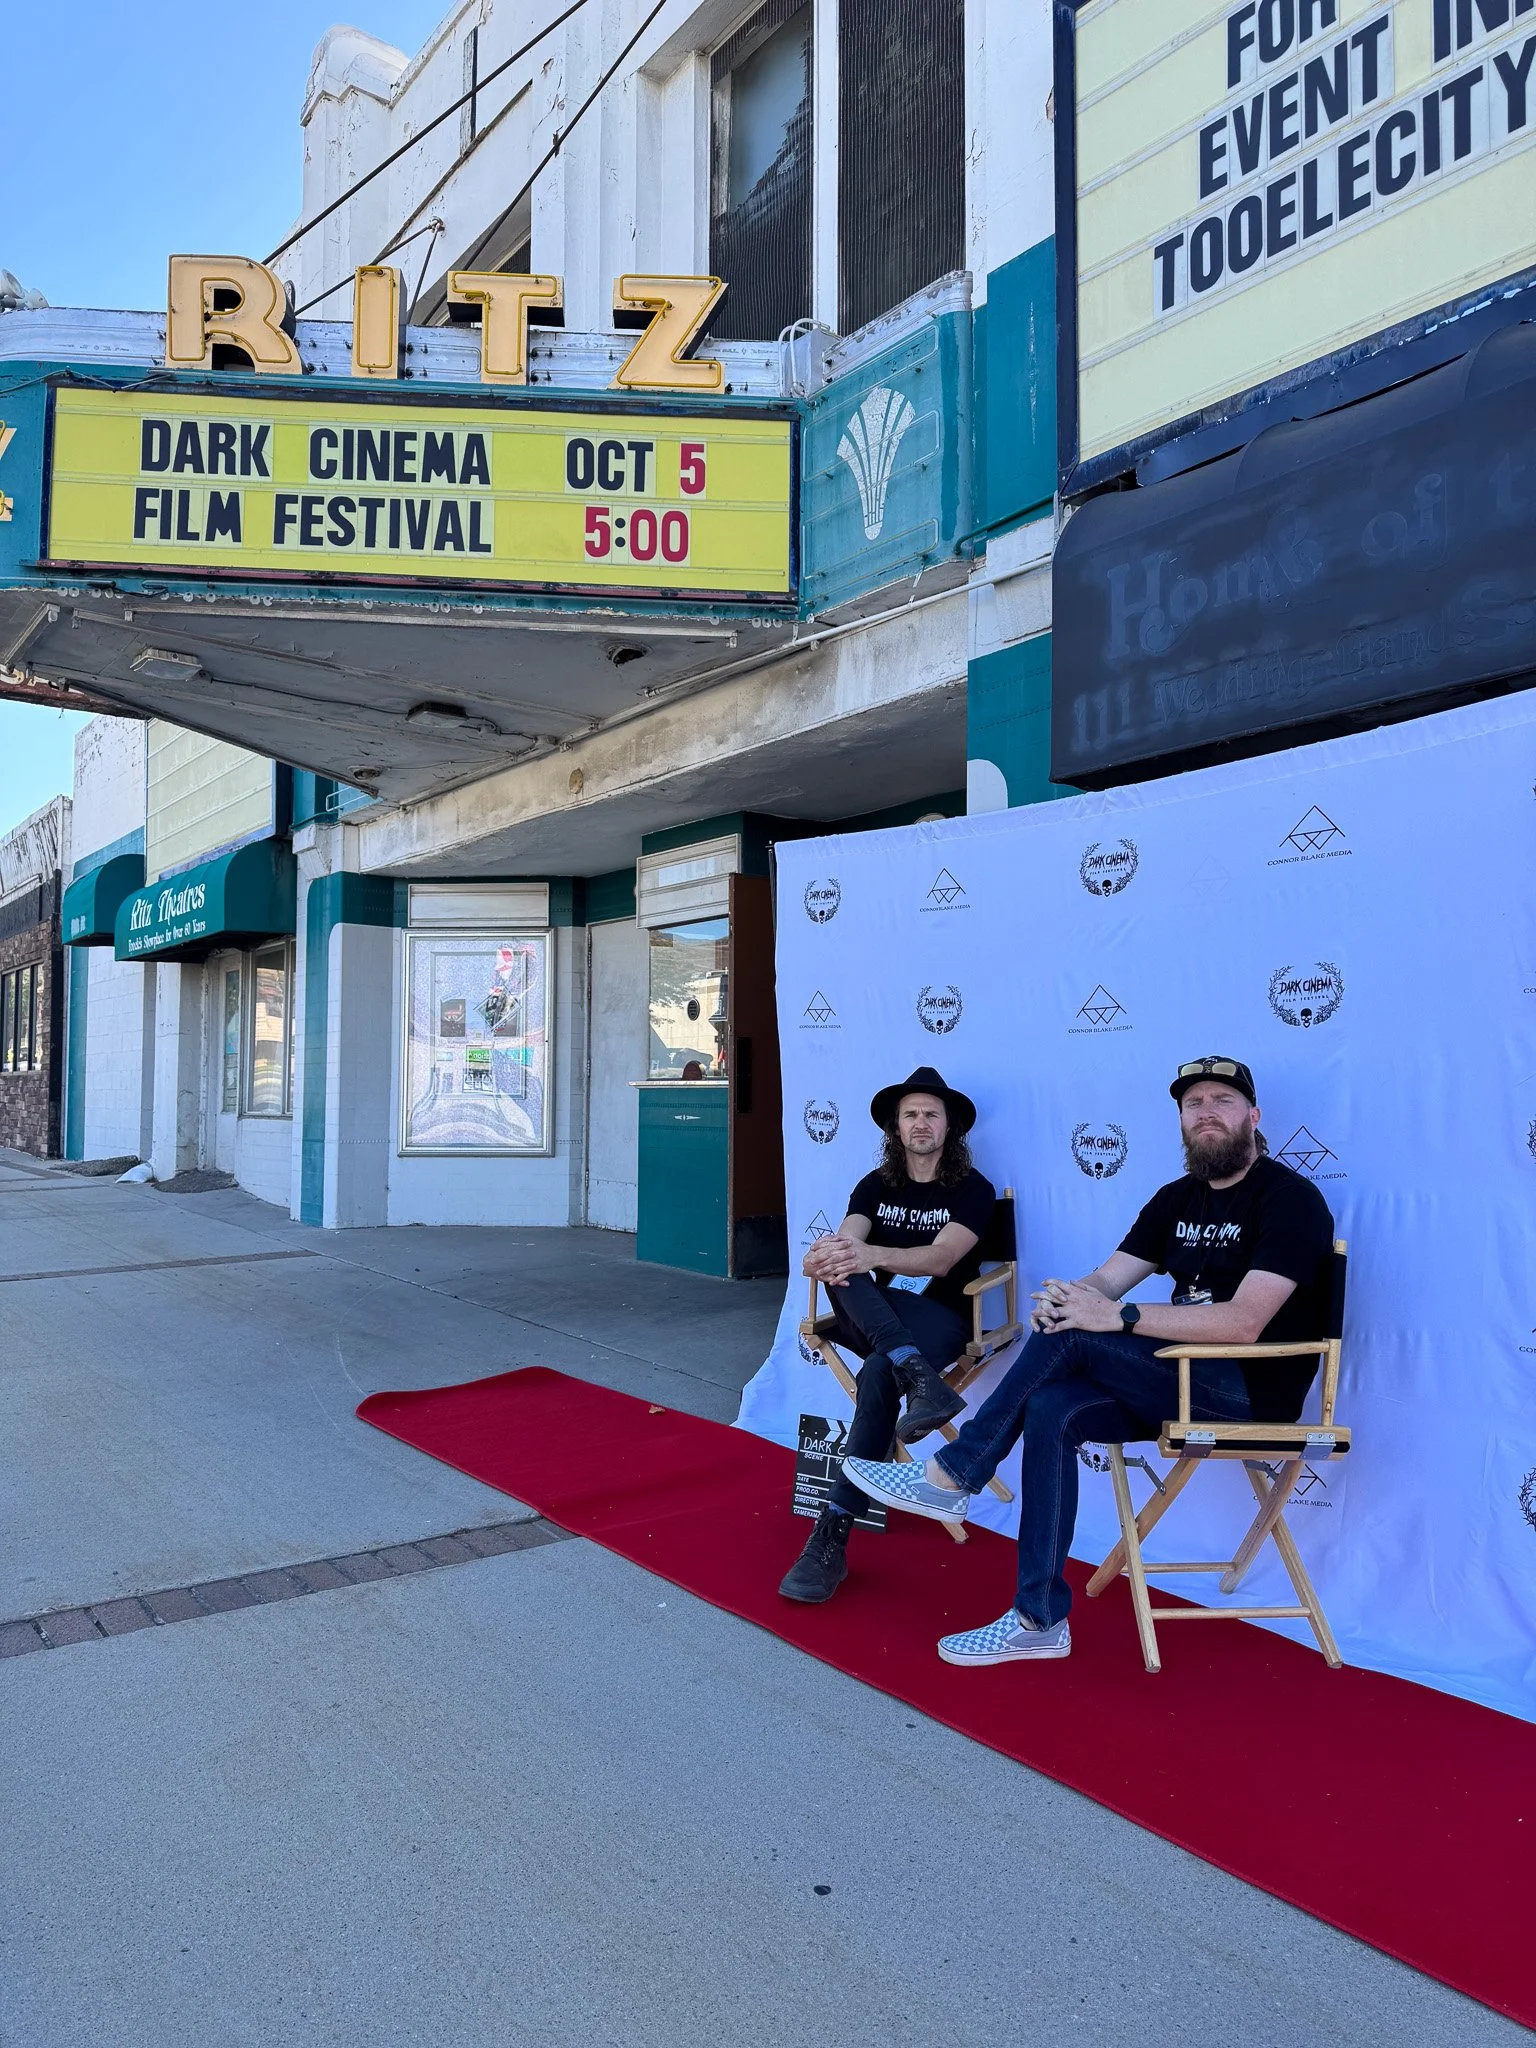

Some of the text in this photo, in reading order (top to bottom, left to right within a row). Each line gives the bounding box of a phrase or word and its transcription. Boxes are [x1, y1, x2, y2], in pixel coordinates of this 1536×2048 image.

[1199, 0, 1536, 200] EVENT IN
[165, 253, 730, 394] RITZ
[140, 419, 706, 495] DARK CINEMA OCT 5
[133, 487, 689, 561] FILM FESTIVAL 5:00
[1087, 851, 1130, 869] DARK CINEMA
[1267, 849, 1353, 866] CONNOR BLAKE MEDIA
[129, 898, 152, 932] Ritz
[157, 882, 206, 926] Theatres
[184, 922, 191, 936] 60
[192, 918, 206, 934] Years
[1277, 975, 1333, 996] DARK CINEMA
[1112, 1024, 1133, 1032] MEDIA
[1078, 1135, 1120, 1151] DARK CINEMA
[1321, 1172, 1348, 1180] MEDIA
[876, 1202, 951, 1225] DARK CINEMA
[803, 1436, 832, 1455] DARK
[803, 1452, 824, 1462] SCENE
[796, 1475, 810, 1483] DATE
[794, 1496, 820, 1507] DIRECTOR
[1286, 1498, 1333, 1508] LAKE MEDIA
